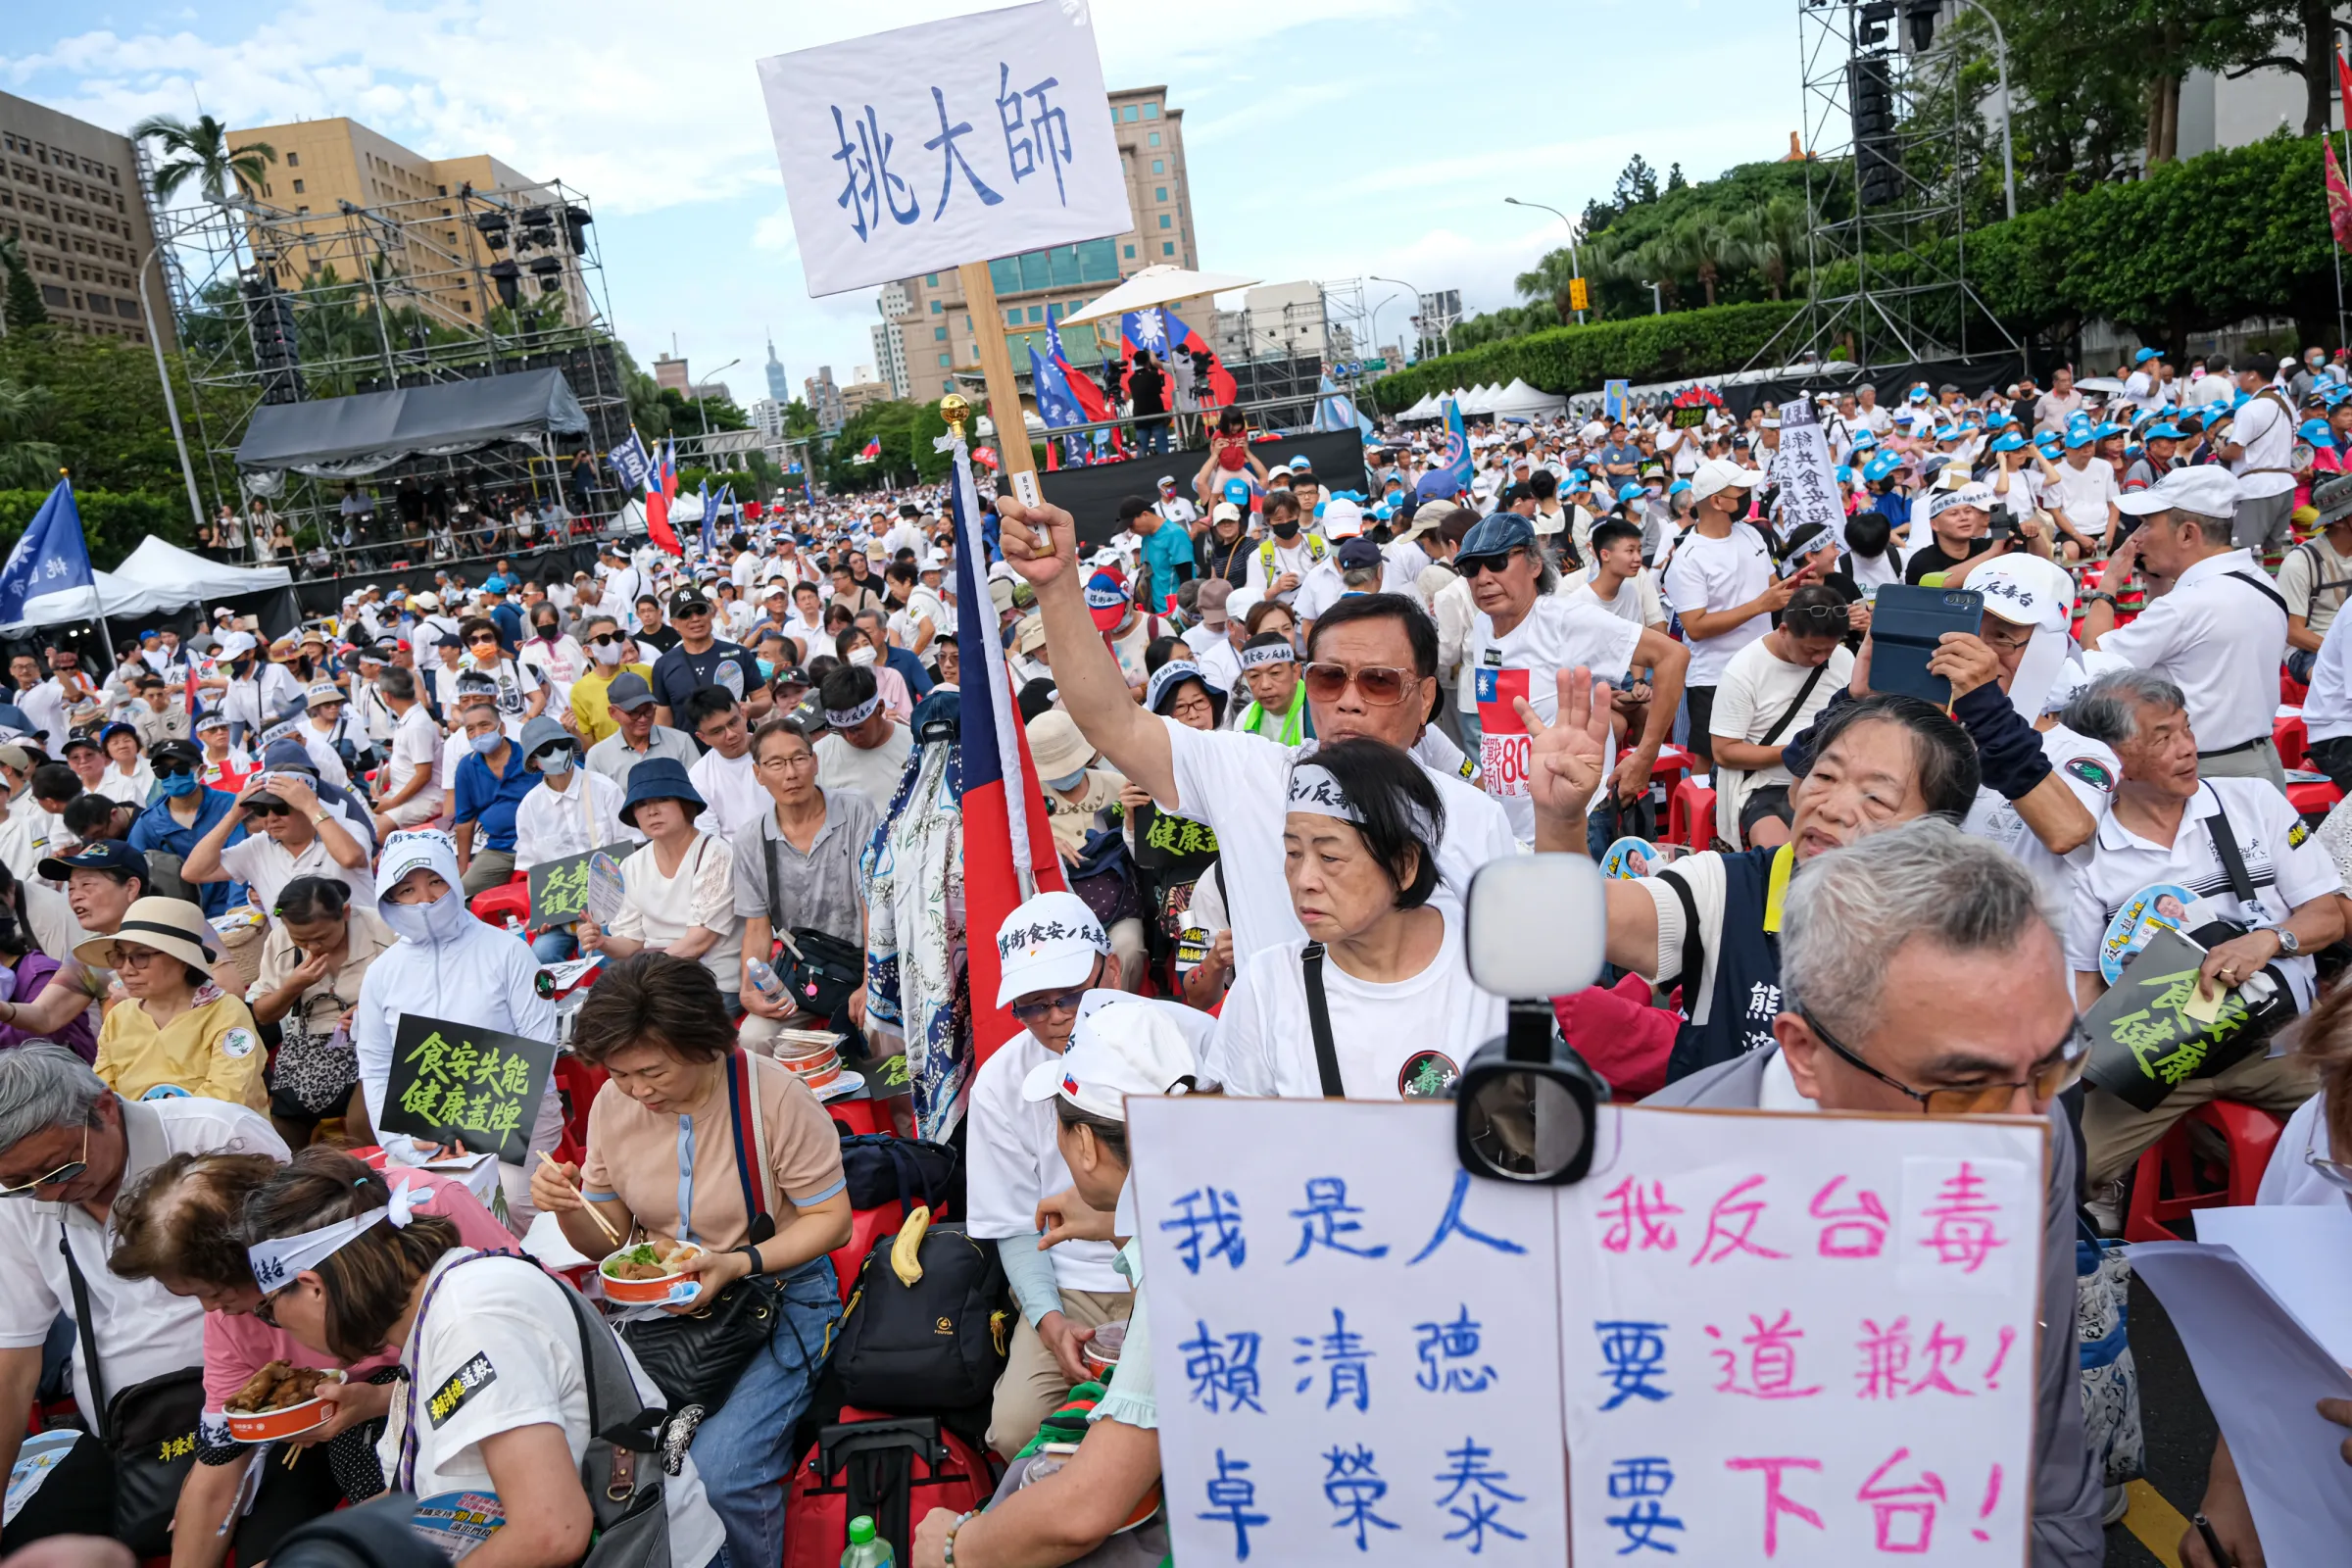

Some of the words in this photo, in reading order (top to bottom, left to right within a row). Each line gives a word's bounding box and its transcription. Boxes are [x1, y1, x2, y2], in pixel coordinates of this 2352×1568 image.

[830, 61, 1072, 244] 挑大師
[399, 1078, 522, 1152] 健康蓋牌
[404, 1031, 530, 1100] 食安失能
[1159, 1169, 1529, 1275] 我是人
[1595, 1162, 2008, 1274] 我反台毒
[1197, 1437, 1529, 1563] 卓榮泰
